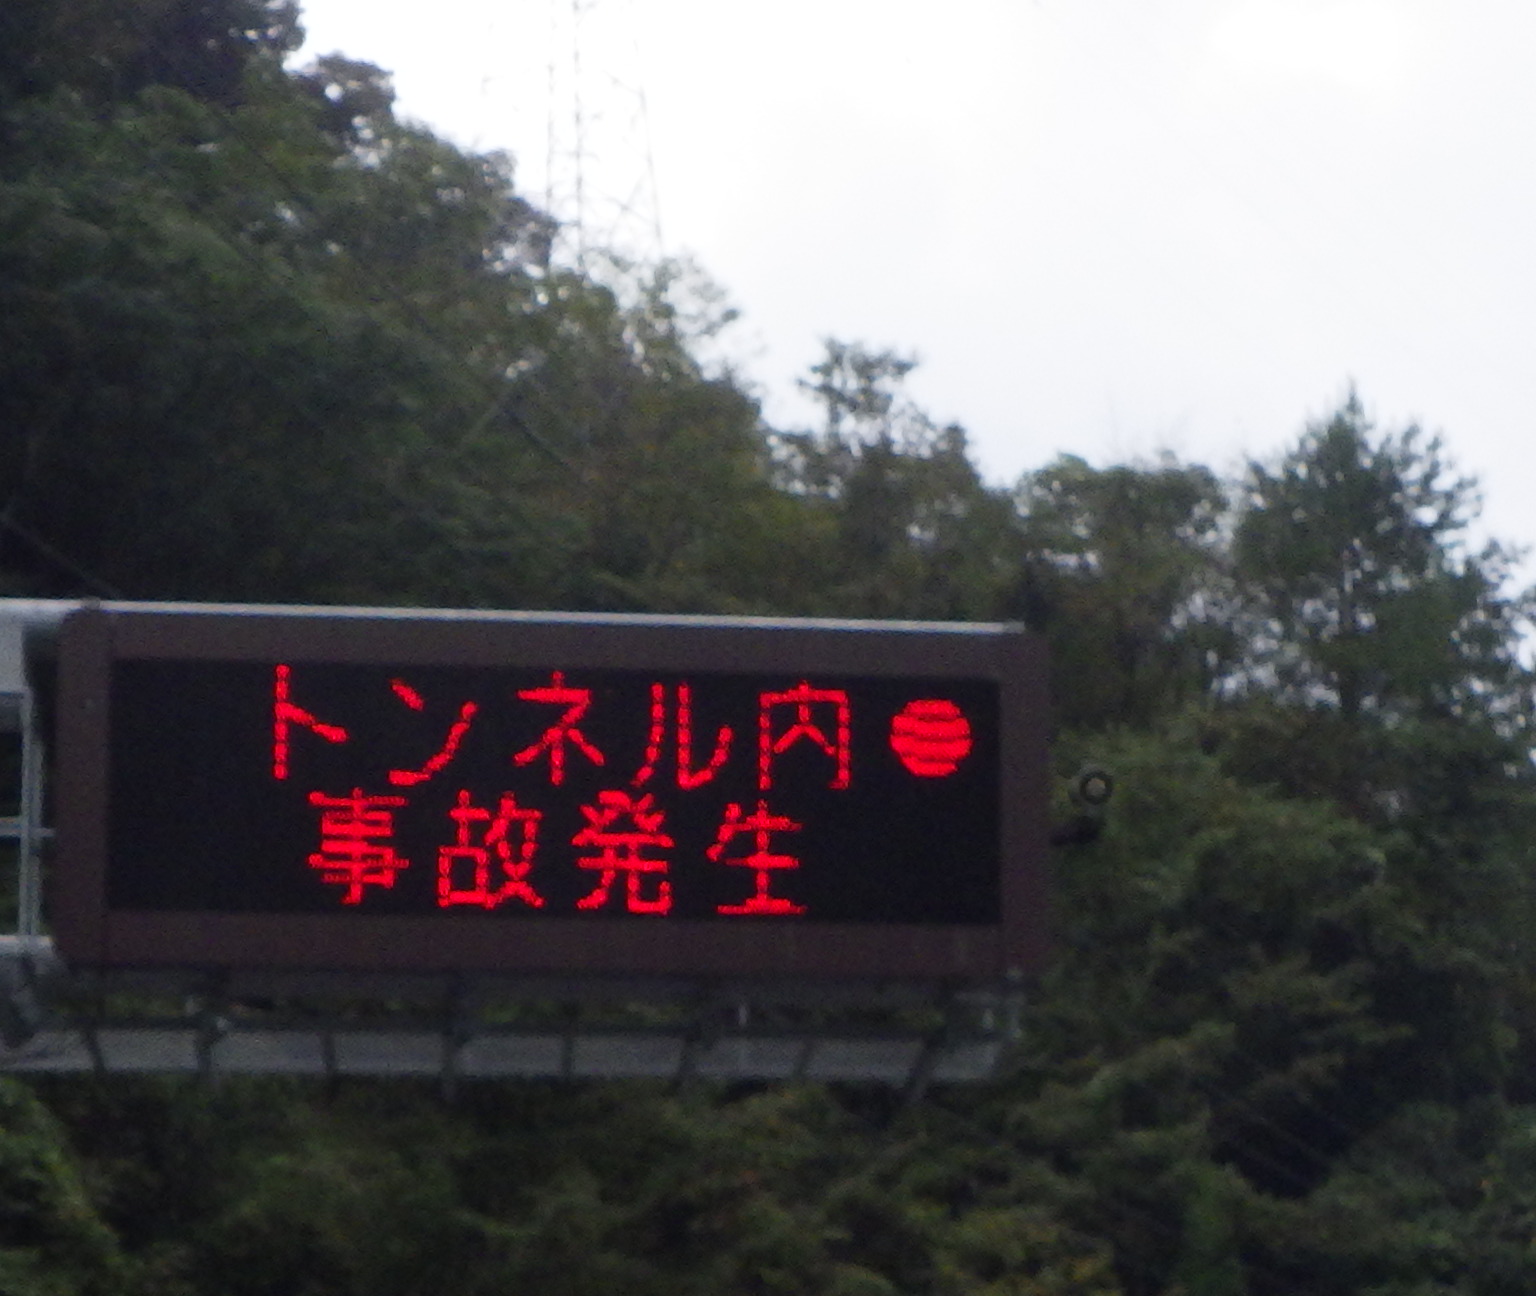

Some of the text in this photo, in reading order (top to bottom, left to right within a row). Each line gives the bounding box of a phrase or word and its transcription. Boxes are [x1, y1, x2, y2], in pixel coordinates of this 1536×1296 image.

[274, 665, 851, 790] トンネル内
[308, 787, 805, 915] 事故発生
